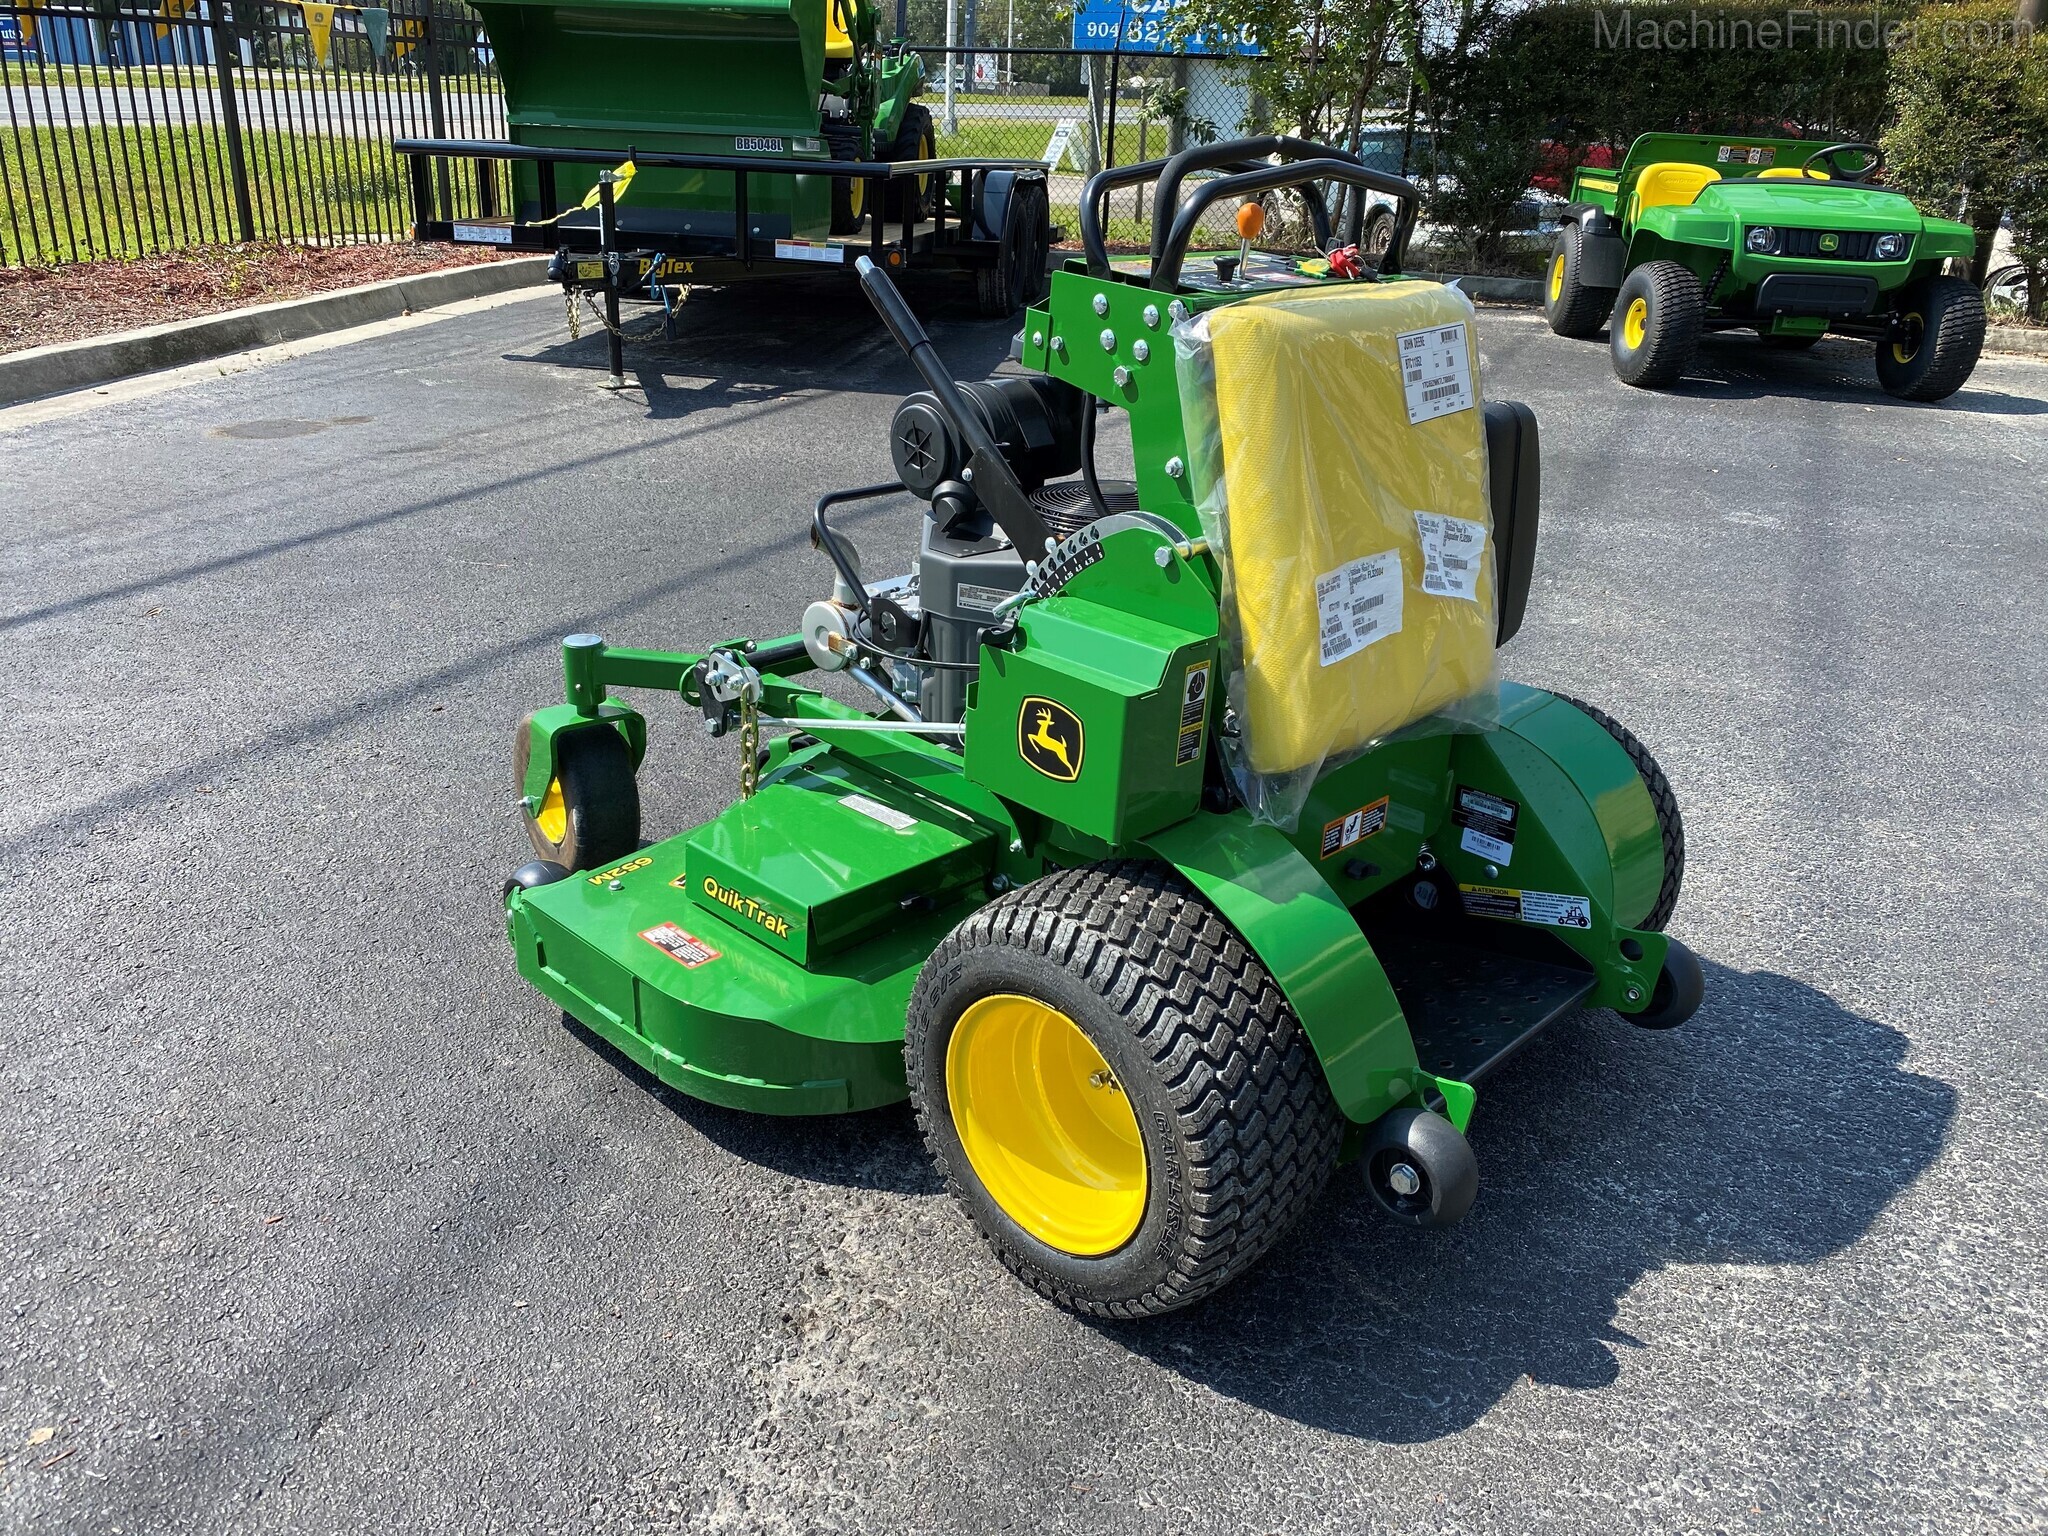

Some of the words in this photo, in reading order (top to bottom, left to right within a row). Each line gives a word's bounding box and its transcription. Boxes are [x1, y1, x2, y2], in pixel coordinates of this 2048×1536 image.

[1087, 22, 1120, 38] 904
[735, 136, 784, 152] BB5048L
[639, 257, 695, 278] BgTex
[1075, 563, 1083, 573] 4.5
[588, 857, 654, 886] 652M
[702, 875, 790, 940] QuikTrak
